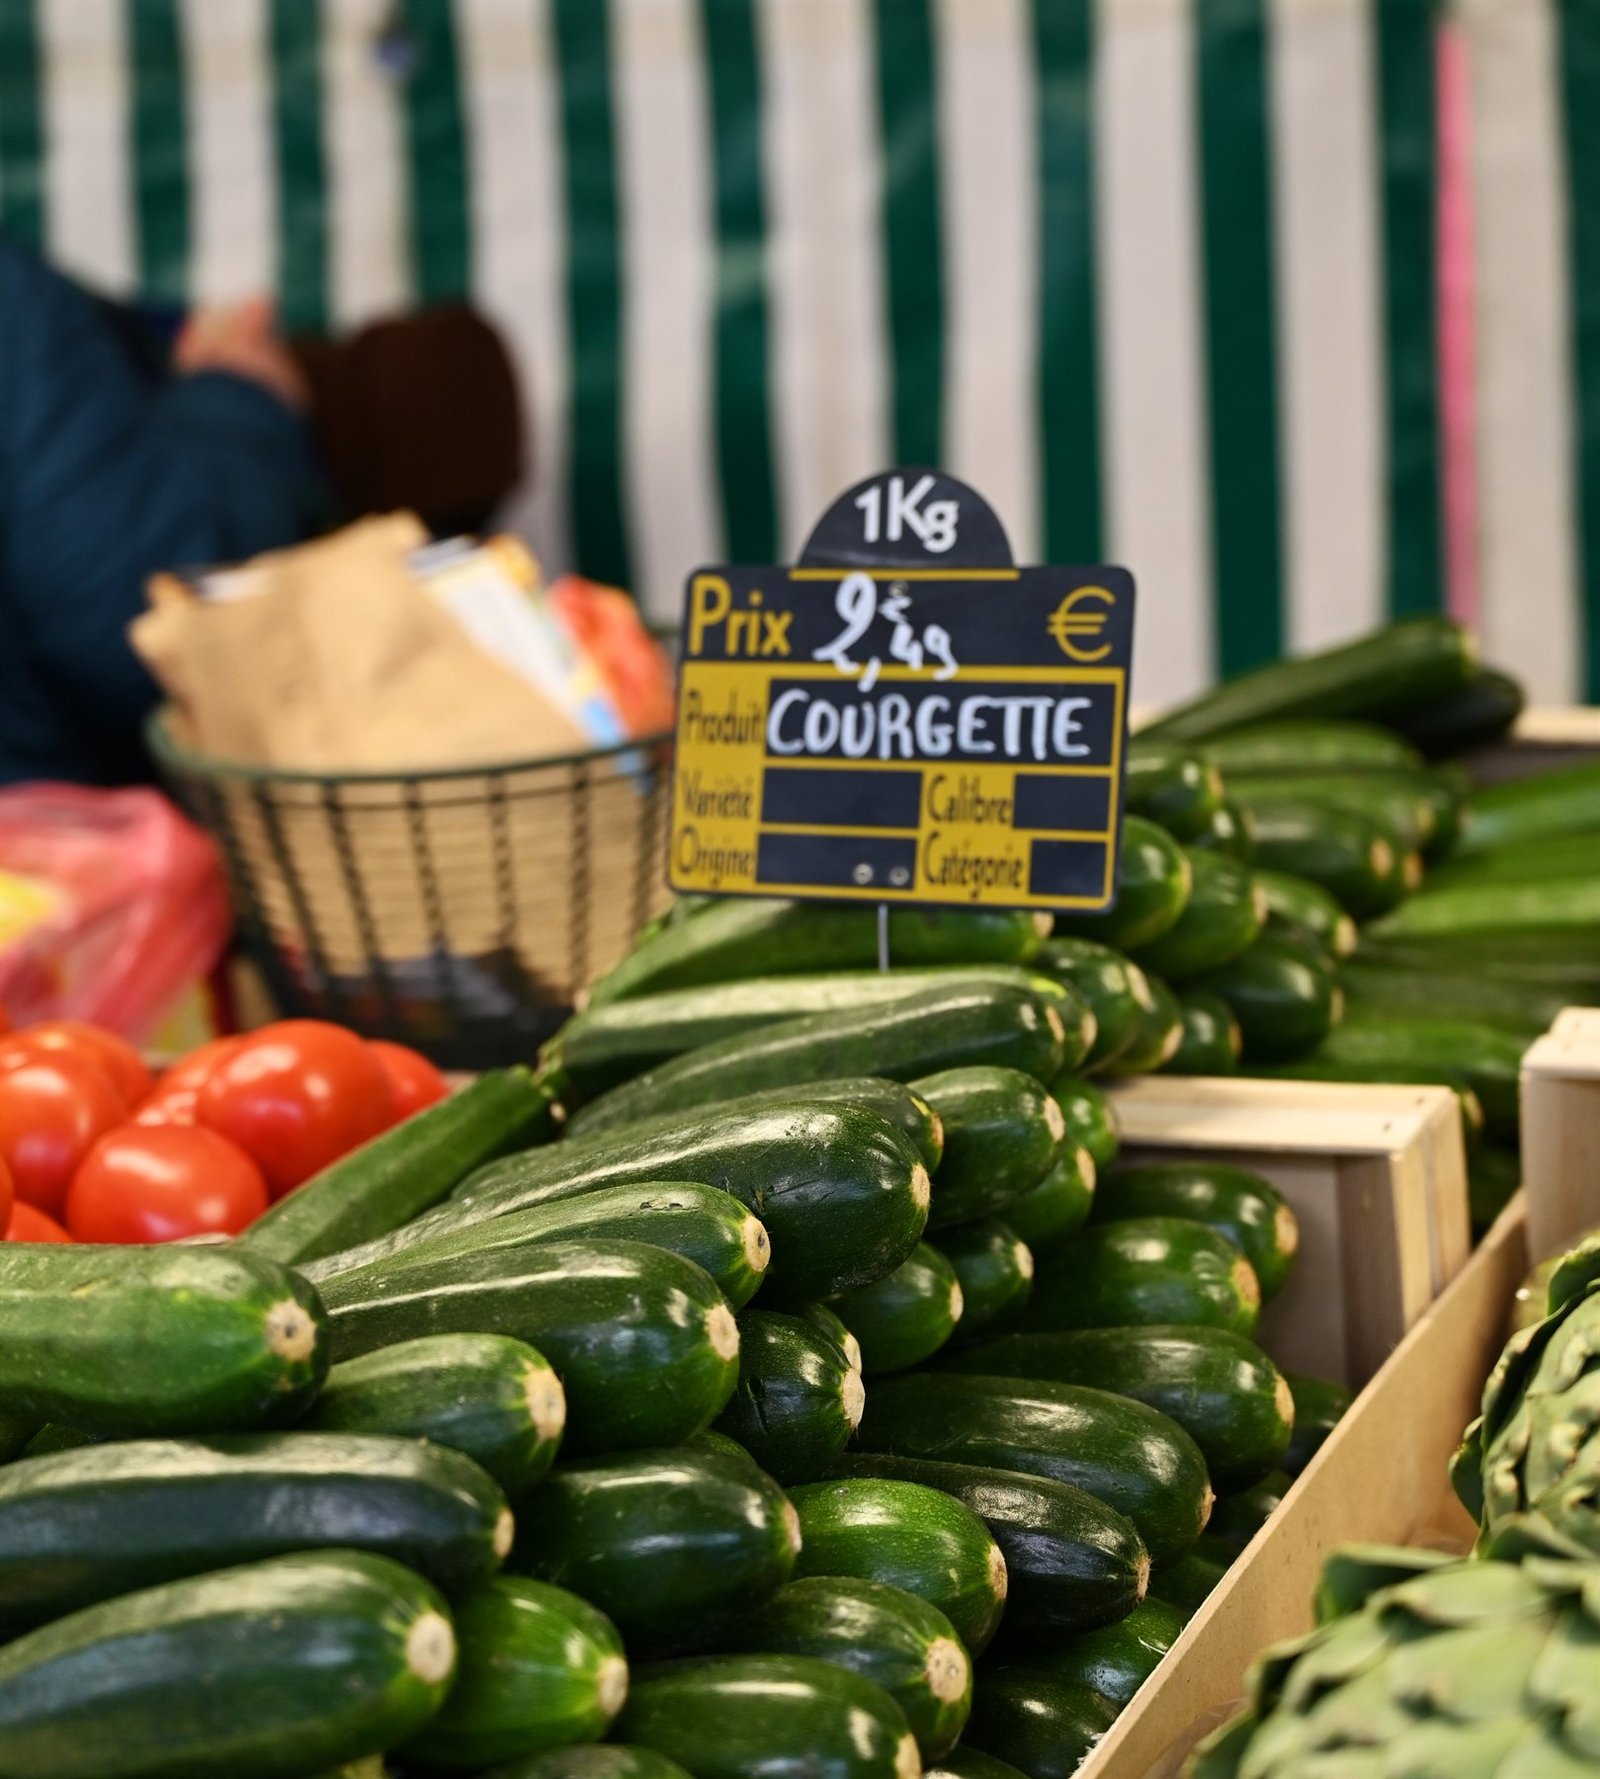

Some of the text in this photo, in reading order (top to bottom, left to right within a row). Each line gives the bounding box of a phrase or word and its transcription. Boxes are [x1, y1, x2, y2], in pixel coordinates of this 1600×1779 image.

[689, 574, 792, 656] Prix
[1047, 585, 1116, 662] €
[681, 688, 1092, 761] Produit COURGETTE
[927, 774, 1013, 824] Calibre
[675, 825, 754, 889] Origine
[922, 831, 1022, 899] Catégorie
